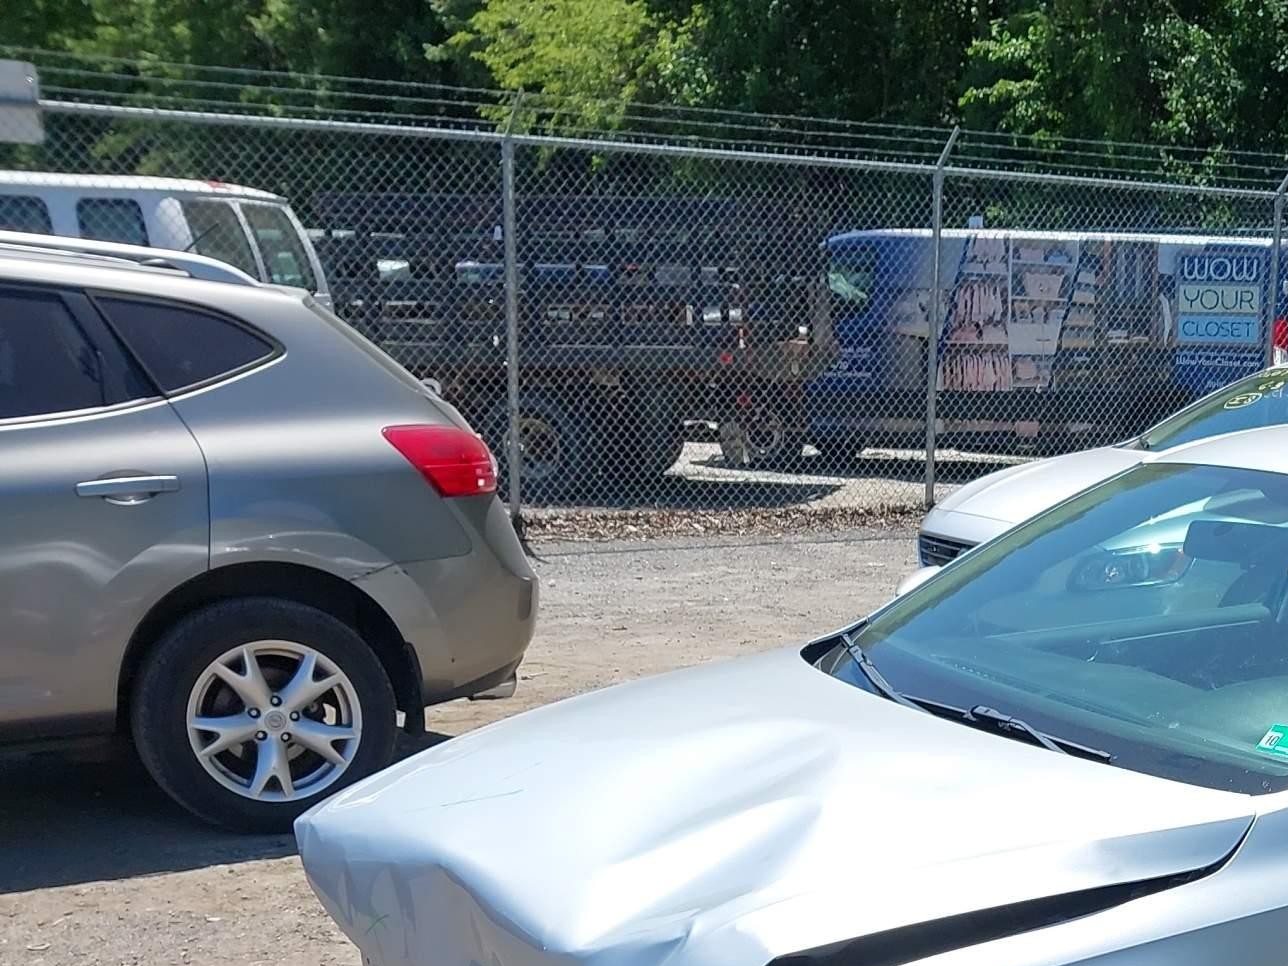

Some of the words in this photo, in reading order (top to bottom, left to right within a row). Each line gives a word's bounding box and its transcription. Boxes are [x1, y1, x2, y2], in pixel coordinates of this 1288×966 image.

[1184, 257, 1258, 281] WOW
[1183, 288, 1255, 311] YOUR
[1182, 320, 1256, 338] CLOSET
[1265, 734, 1280, 747] 10
